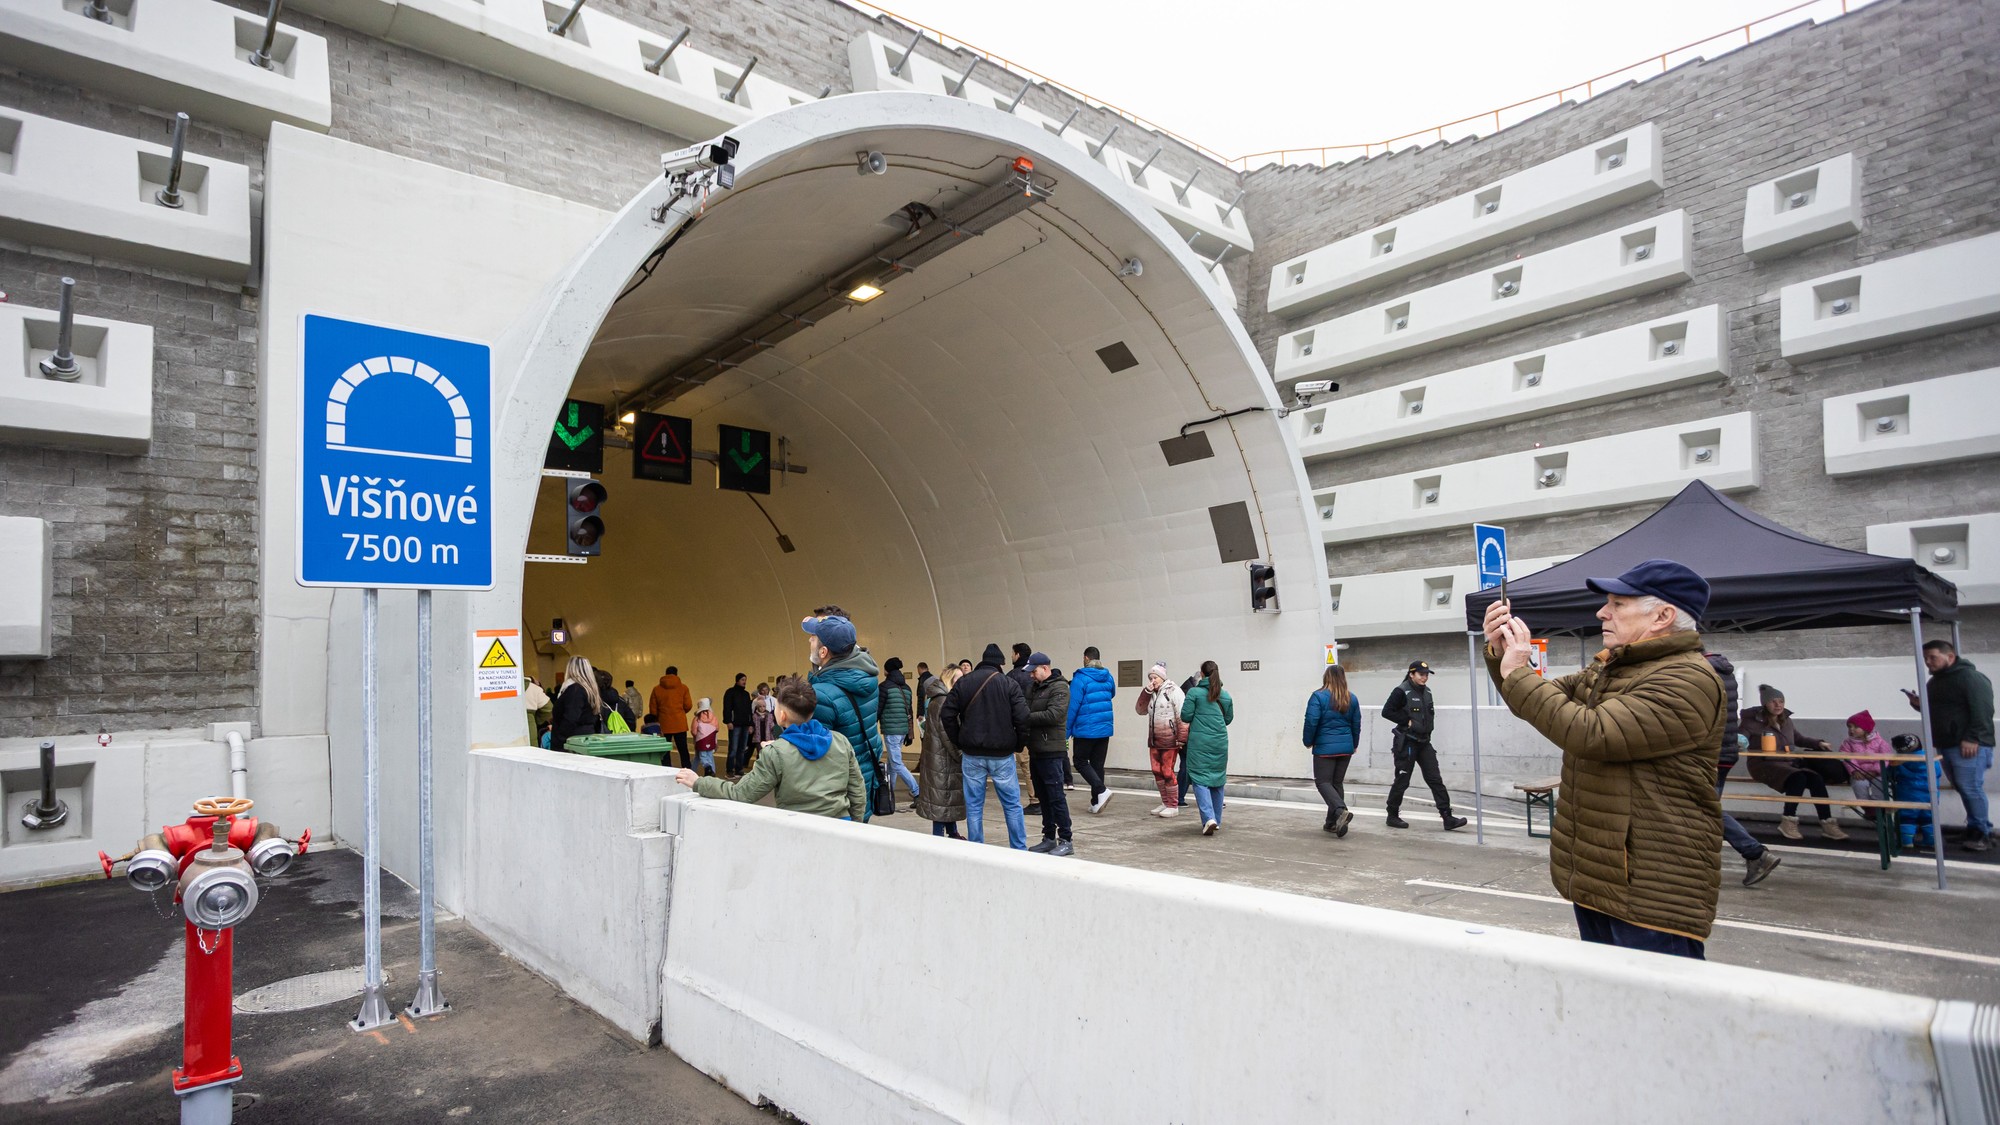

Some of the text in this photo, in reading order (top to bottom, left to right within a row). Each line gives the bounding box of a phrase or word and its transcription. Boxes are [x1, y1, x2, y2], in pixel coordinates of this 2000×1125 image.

[320, 474, 478, 525] Višňové
[342, 533, 459, 565] 7500 m
